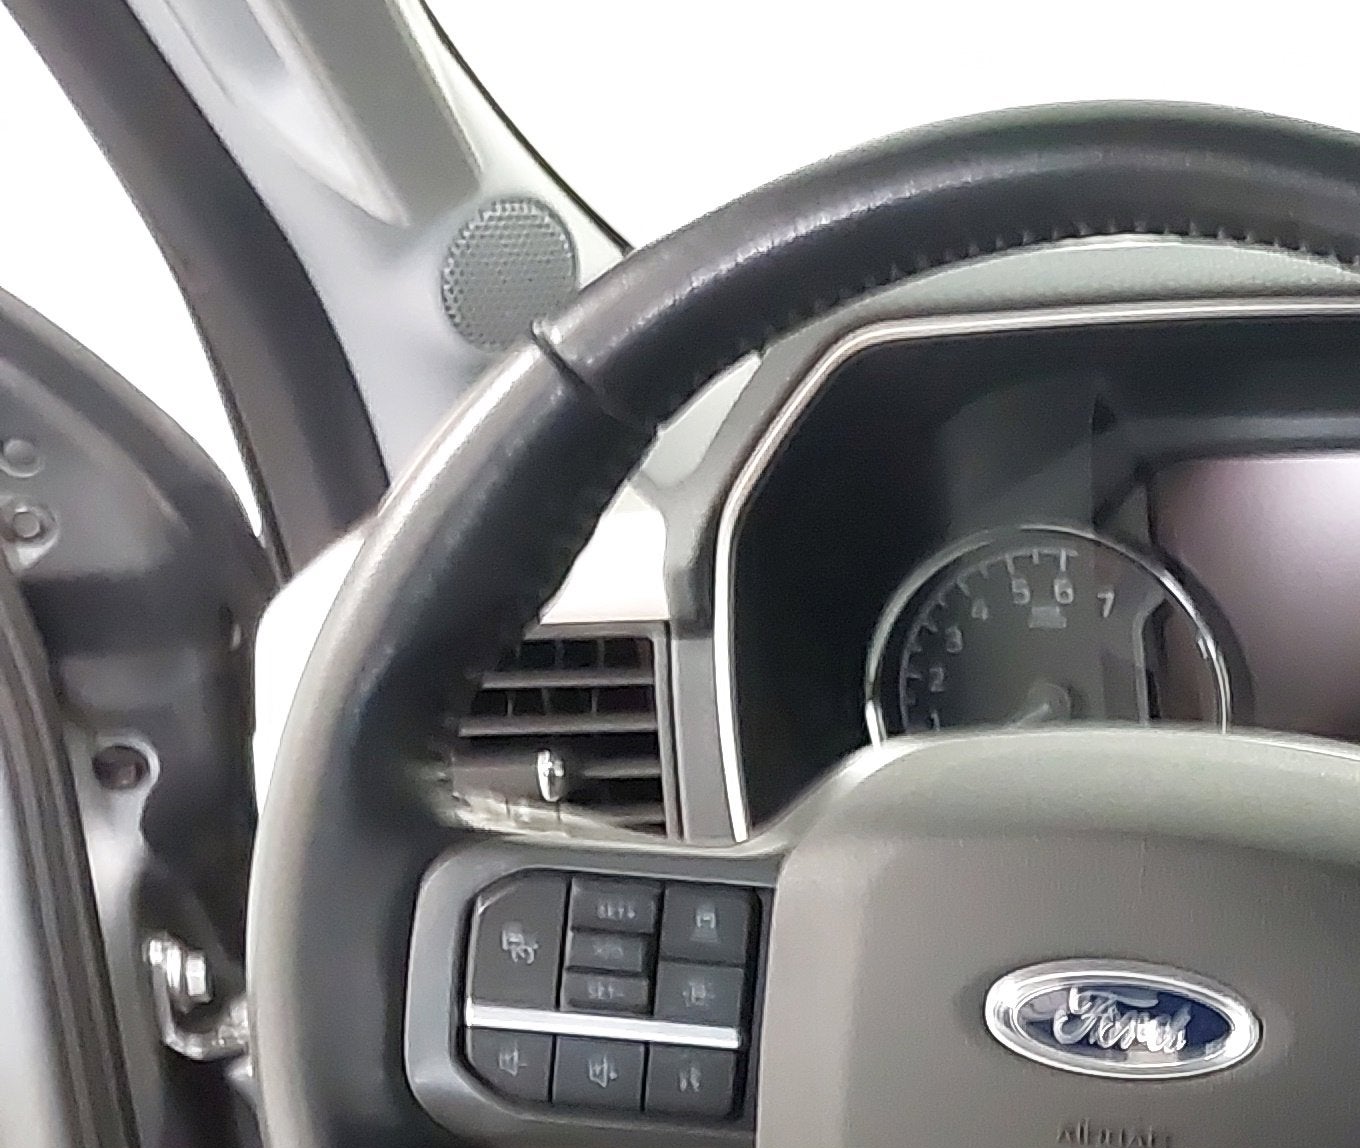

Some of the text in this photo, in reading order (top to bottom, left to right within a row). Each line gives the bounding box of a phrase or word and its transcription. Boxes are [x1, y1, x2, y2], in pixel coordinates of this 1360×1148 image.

[1011, 576, 1031, 605] 5
[1053, 576, 1074, 605] 6
[1097, 588, 1115, 619] 7
[1052, 986, 1192, 1054] Ford
